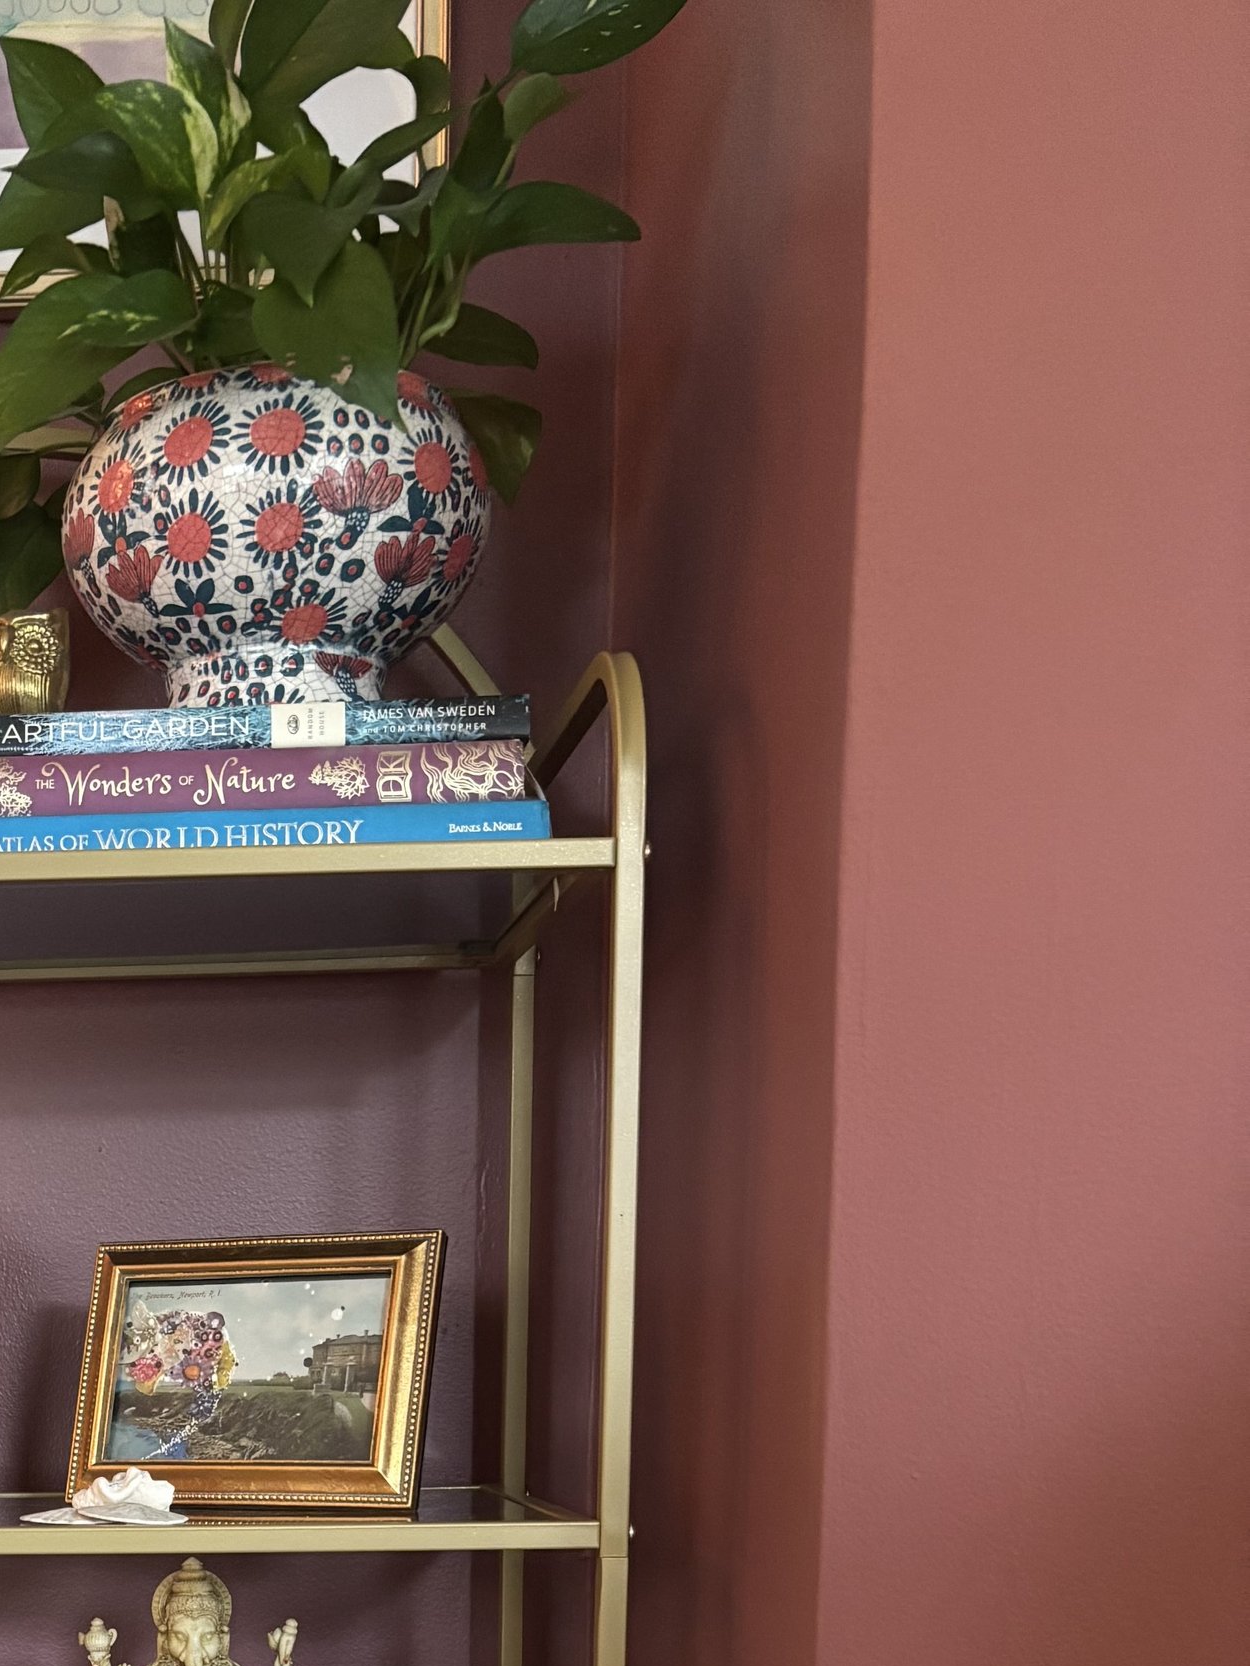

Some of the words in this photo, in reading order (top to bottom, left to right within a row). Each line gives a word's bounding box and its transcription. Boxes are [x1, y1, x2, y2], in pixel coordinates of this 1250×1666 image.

[362, 707, 403, 721] JAMES
[407, 706, 433, 718] VAN
[437, 704, 496, 717] SWEDEN
[1, 720, 115, 745] ARTFUL
[122, 715, 250, 740] GARDEN
[382, 724, 407, 733] TOM
[408, 721, 488, 733] CHRISTOPHER
[34, 778, 55, 790] THE
[41, 761, 172, 807] Wonders
[178, 774, 195, 786] OF
[192, 756, 296, 806] Nature
[482, 821, 493, 832] &
[493, 820, 523, 832] NOBLE
[59, 834, 89, 851] OF
[92, 825, 219, 850] WORLD
[224, 819, 364, 847] HISTORY
